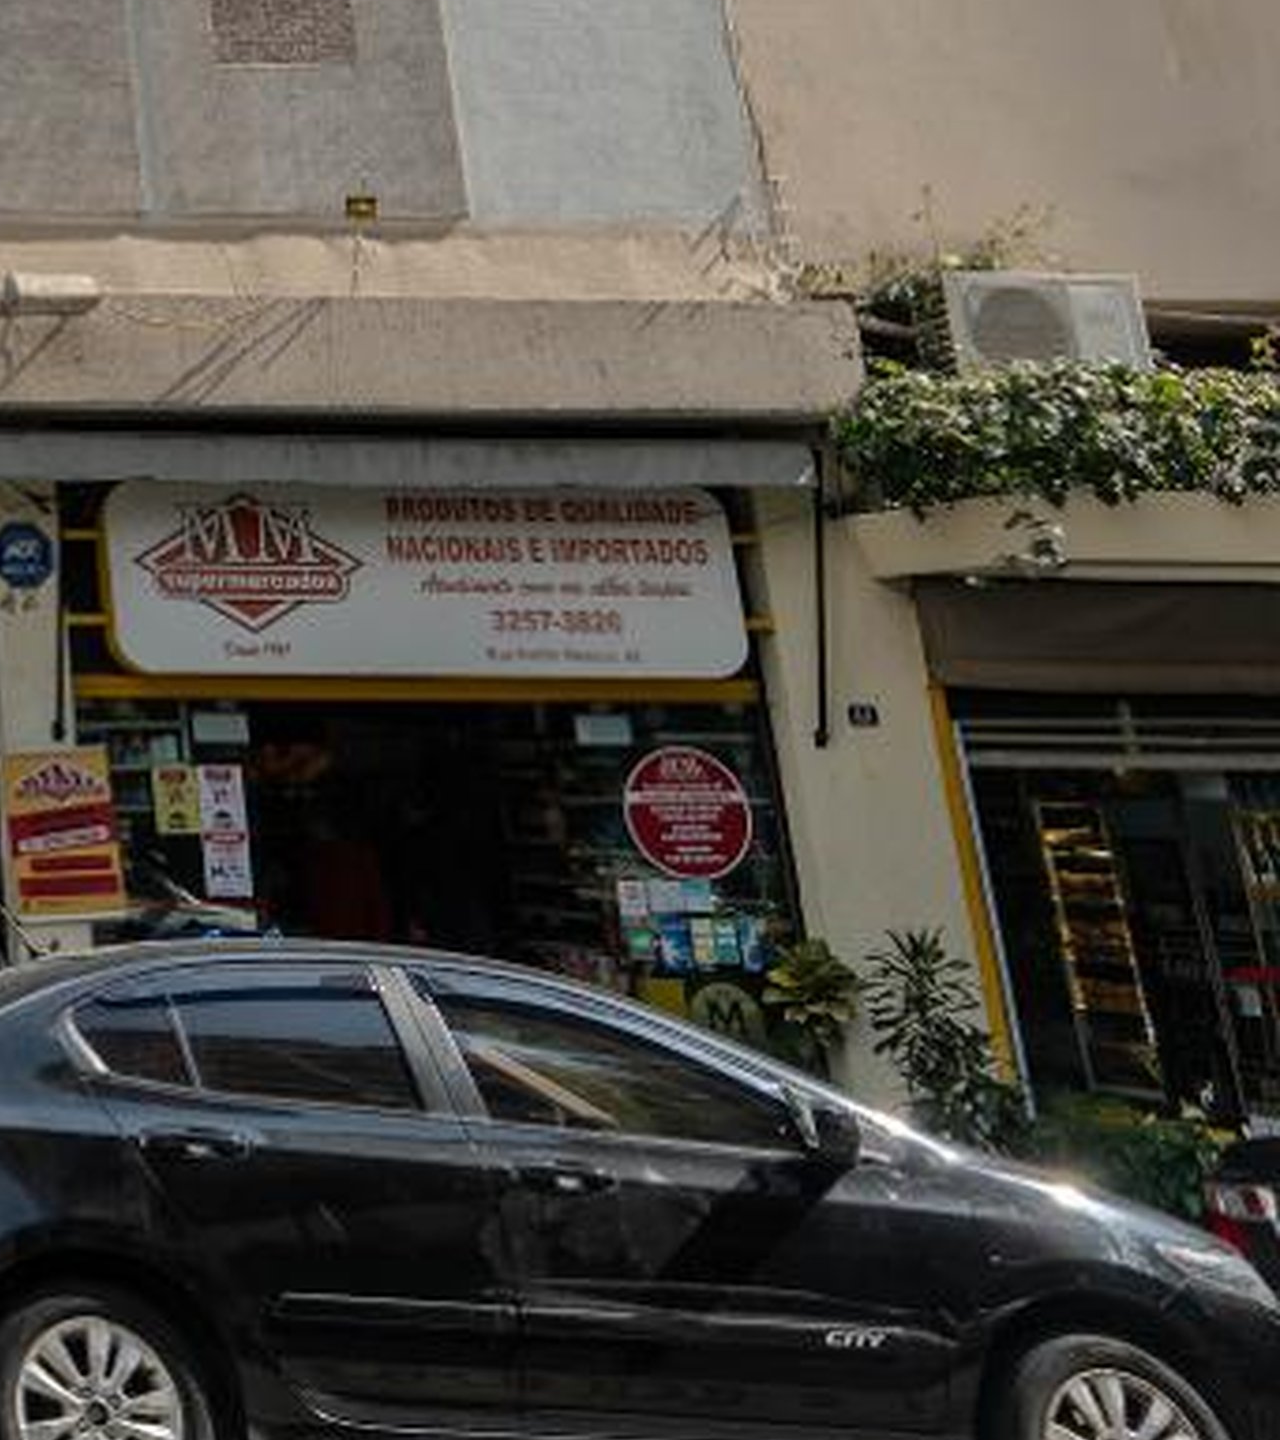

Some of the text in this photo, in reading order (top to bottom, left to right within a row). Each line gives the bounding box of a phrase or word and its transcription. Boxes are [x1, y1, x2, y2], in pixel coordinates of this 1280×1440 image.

[384, 497, 700, 524] PRODUTOS DE QUALIDADE
[386, 535, 709, 566] NACIONAIS E IMPORTADOS
